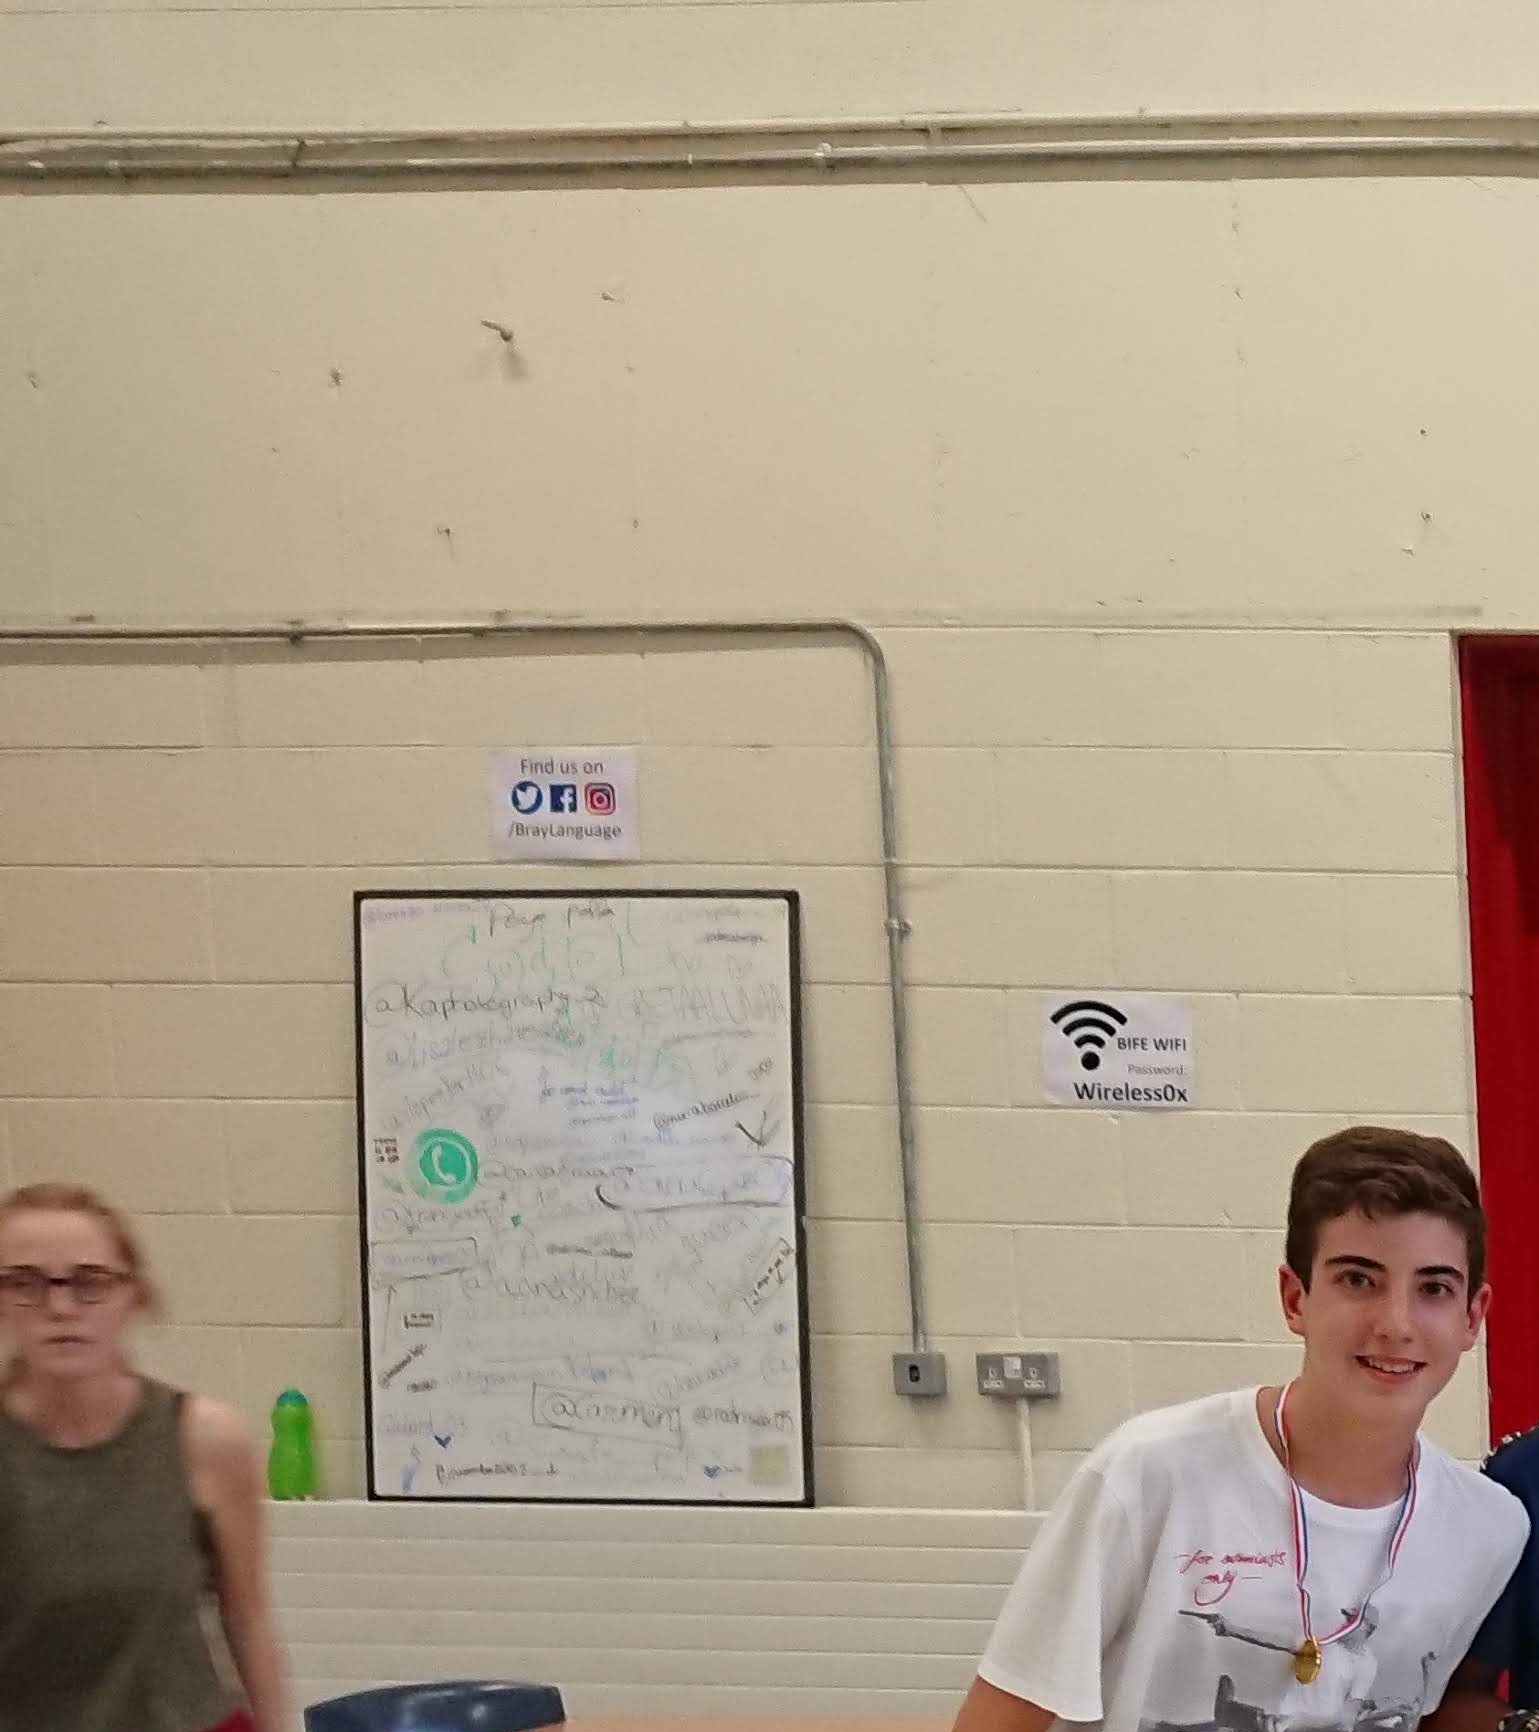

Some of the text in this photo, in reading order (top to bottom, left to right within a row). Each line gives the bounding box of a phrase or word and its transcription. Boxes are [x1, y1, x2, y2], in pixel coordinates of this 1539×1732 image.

[520, 758, 604, 775] Find us on
[509, 822, 621, 840] /BrayLanguage
[1117, 1037, 1187, 1051] BIFE WIFI
[1127, 1063, 1187, 1076] Password:
